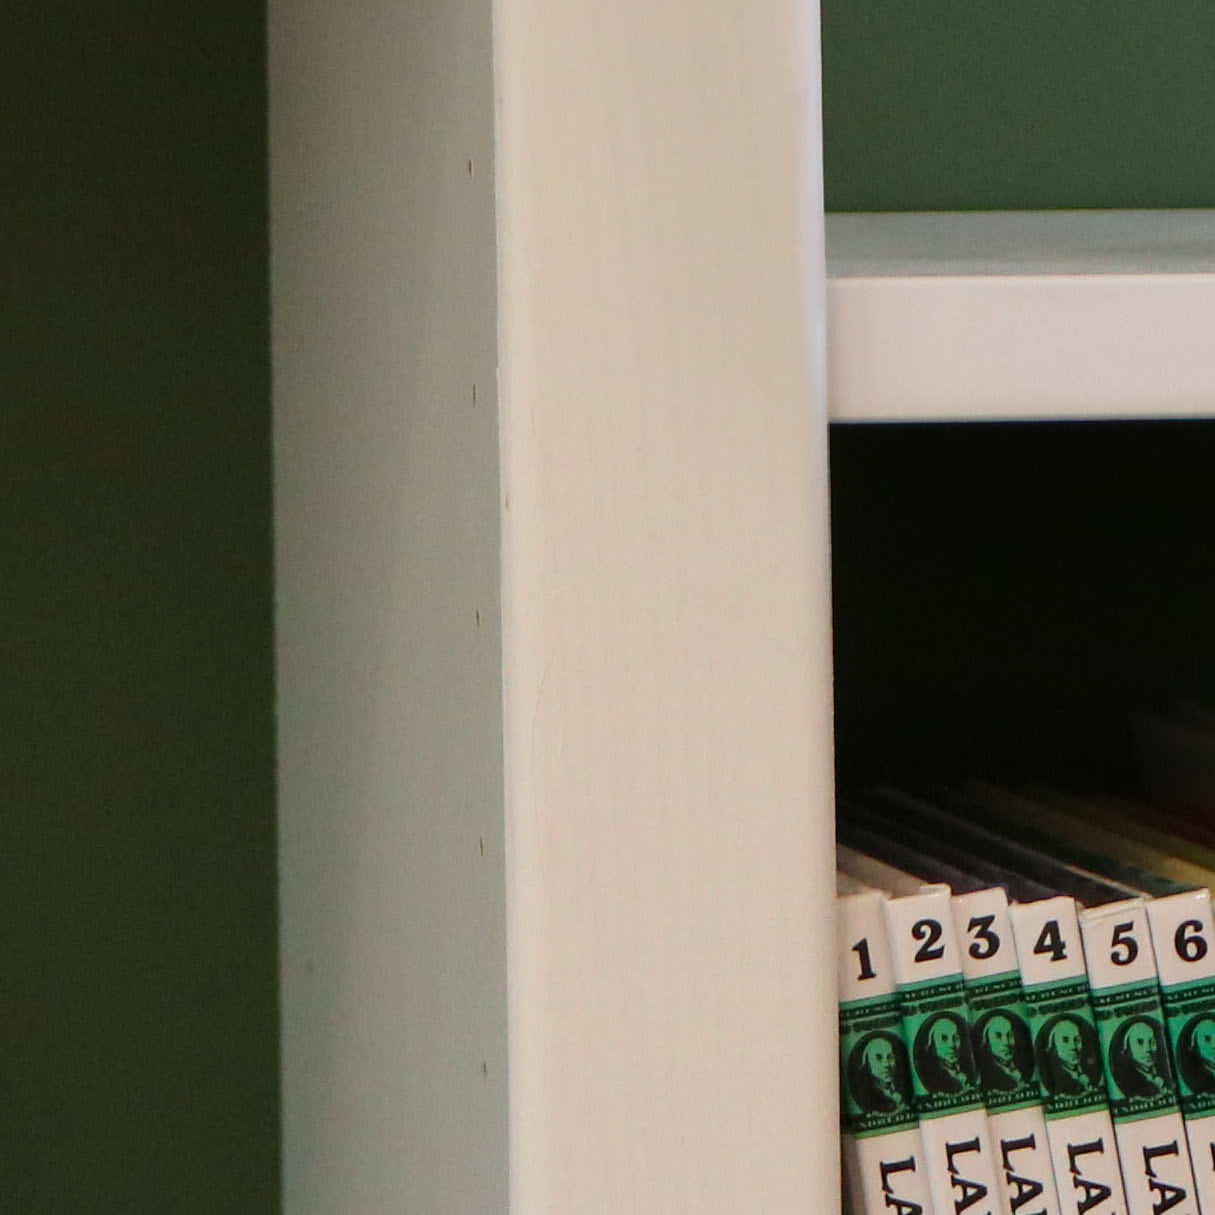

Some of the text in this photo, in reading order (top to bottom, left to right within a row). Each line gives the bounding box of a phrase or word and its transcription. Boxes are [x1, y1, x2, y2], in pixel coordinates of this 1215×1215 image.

[912, 920, 944, 962] 2
[968, 916, 999, 959] 3
[1034, 921, 1067, 961] 4
[1111, 922, 1138, 965] 5
[1175, 920, 1207, 962] 6
[852, 939, 876, 980] 1
[946, 1137, 991, 1215] LA
[1001, 1134, 1047, 1215] LA
[1068, 1139, 1111, 1215] LA
